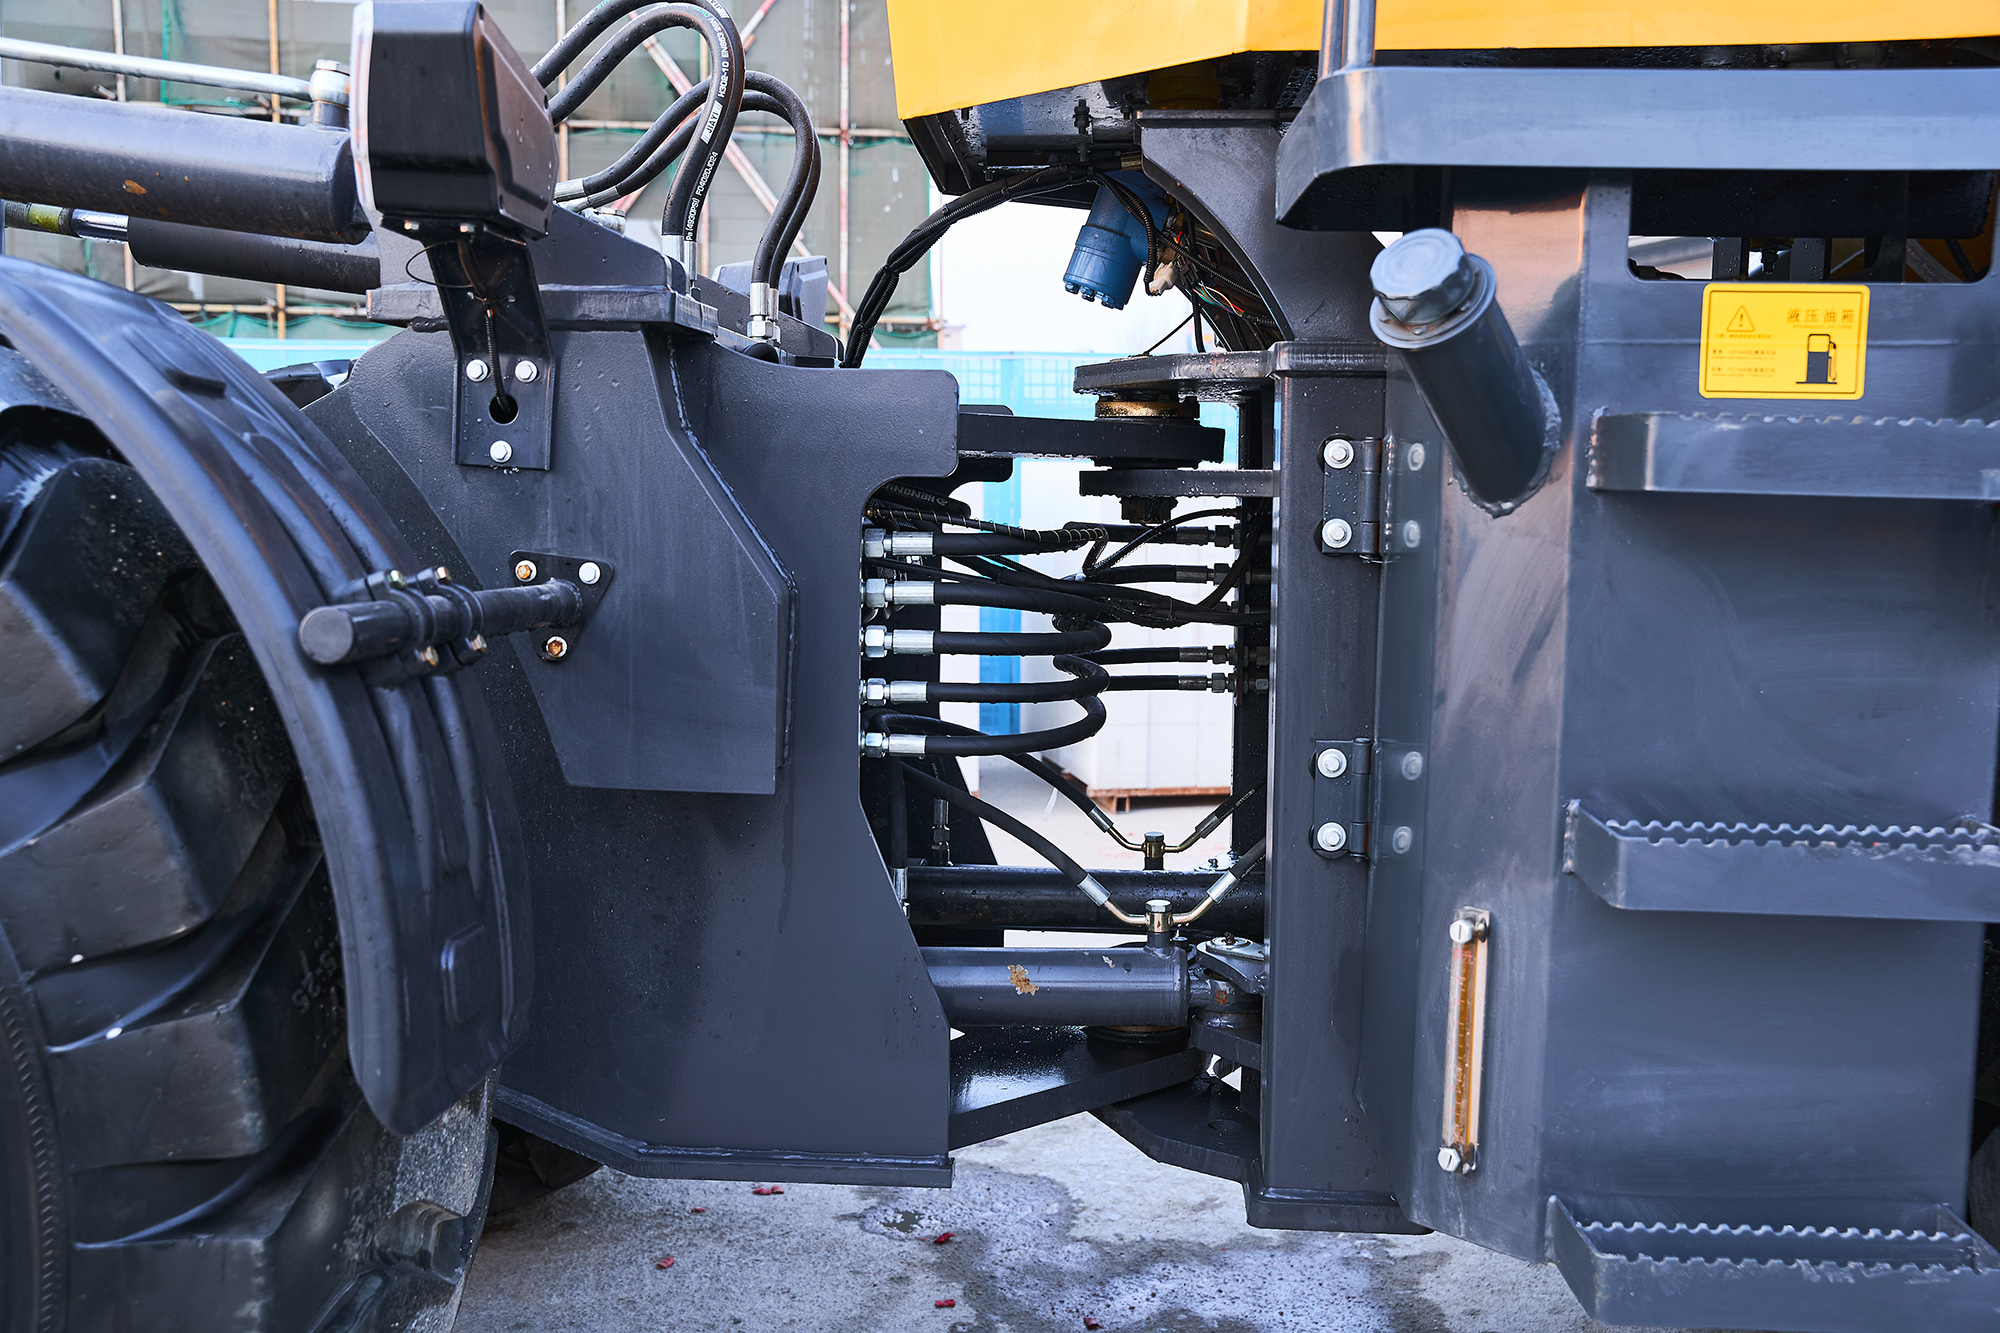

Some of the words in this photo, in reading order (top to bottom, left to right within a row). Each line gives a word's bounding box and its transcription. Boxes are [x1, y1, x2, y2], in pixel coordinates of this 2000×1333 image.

[718, 61, 730, 98] H302-10
[1786, 307, 1855, 323] 液压油箱
